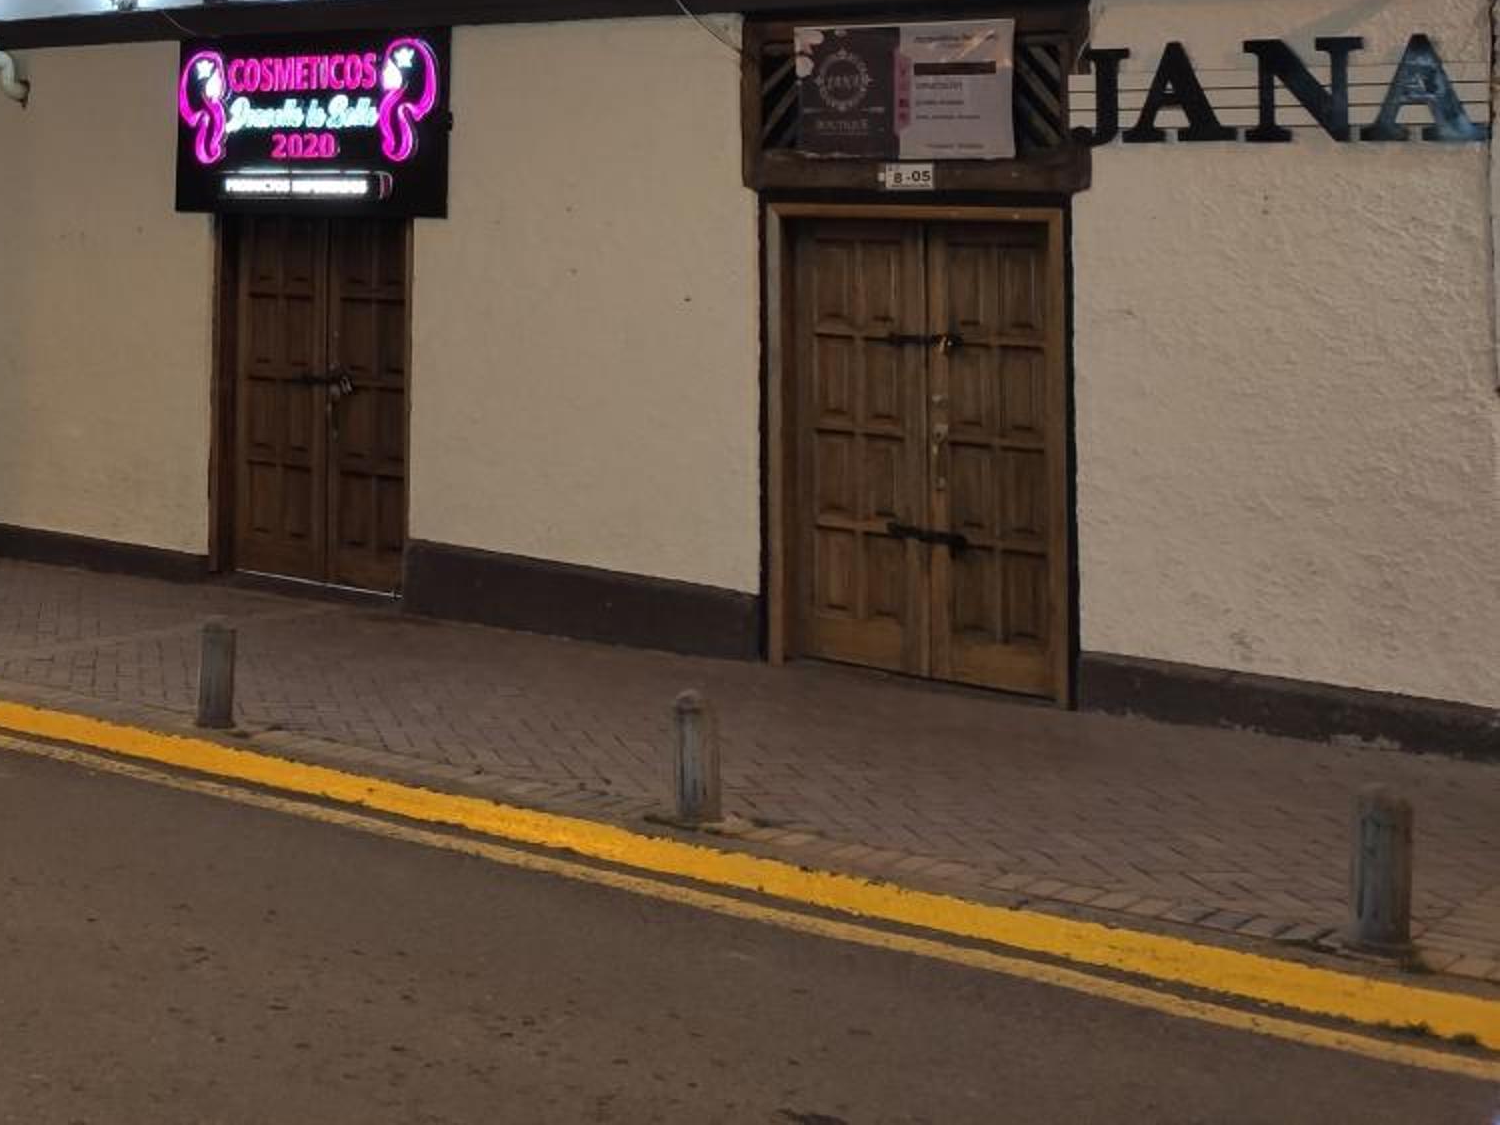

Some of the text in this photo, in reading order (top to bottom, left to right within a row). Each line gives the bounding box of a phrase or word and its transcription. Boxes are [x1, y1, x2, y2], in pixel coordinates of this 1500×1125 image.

[228, 52, 378, 92] COSMETICOS
[1071, 33, 1491, 146] JANA
[271, 133, 337, 159] 2020
